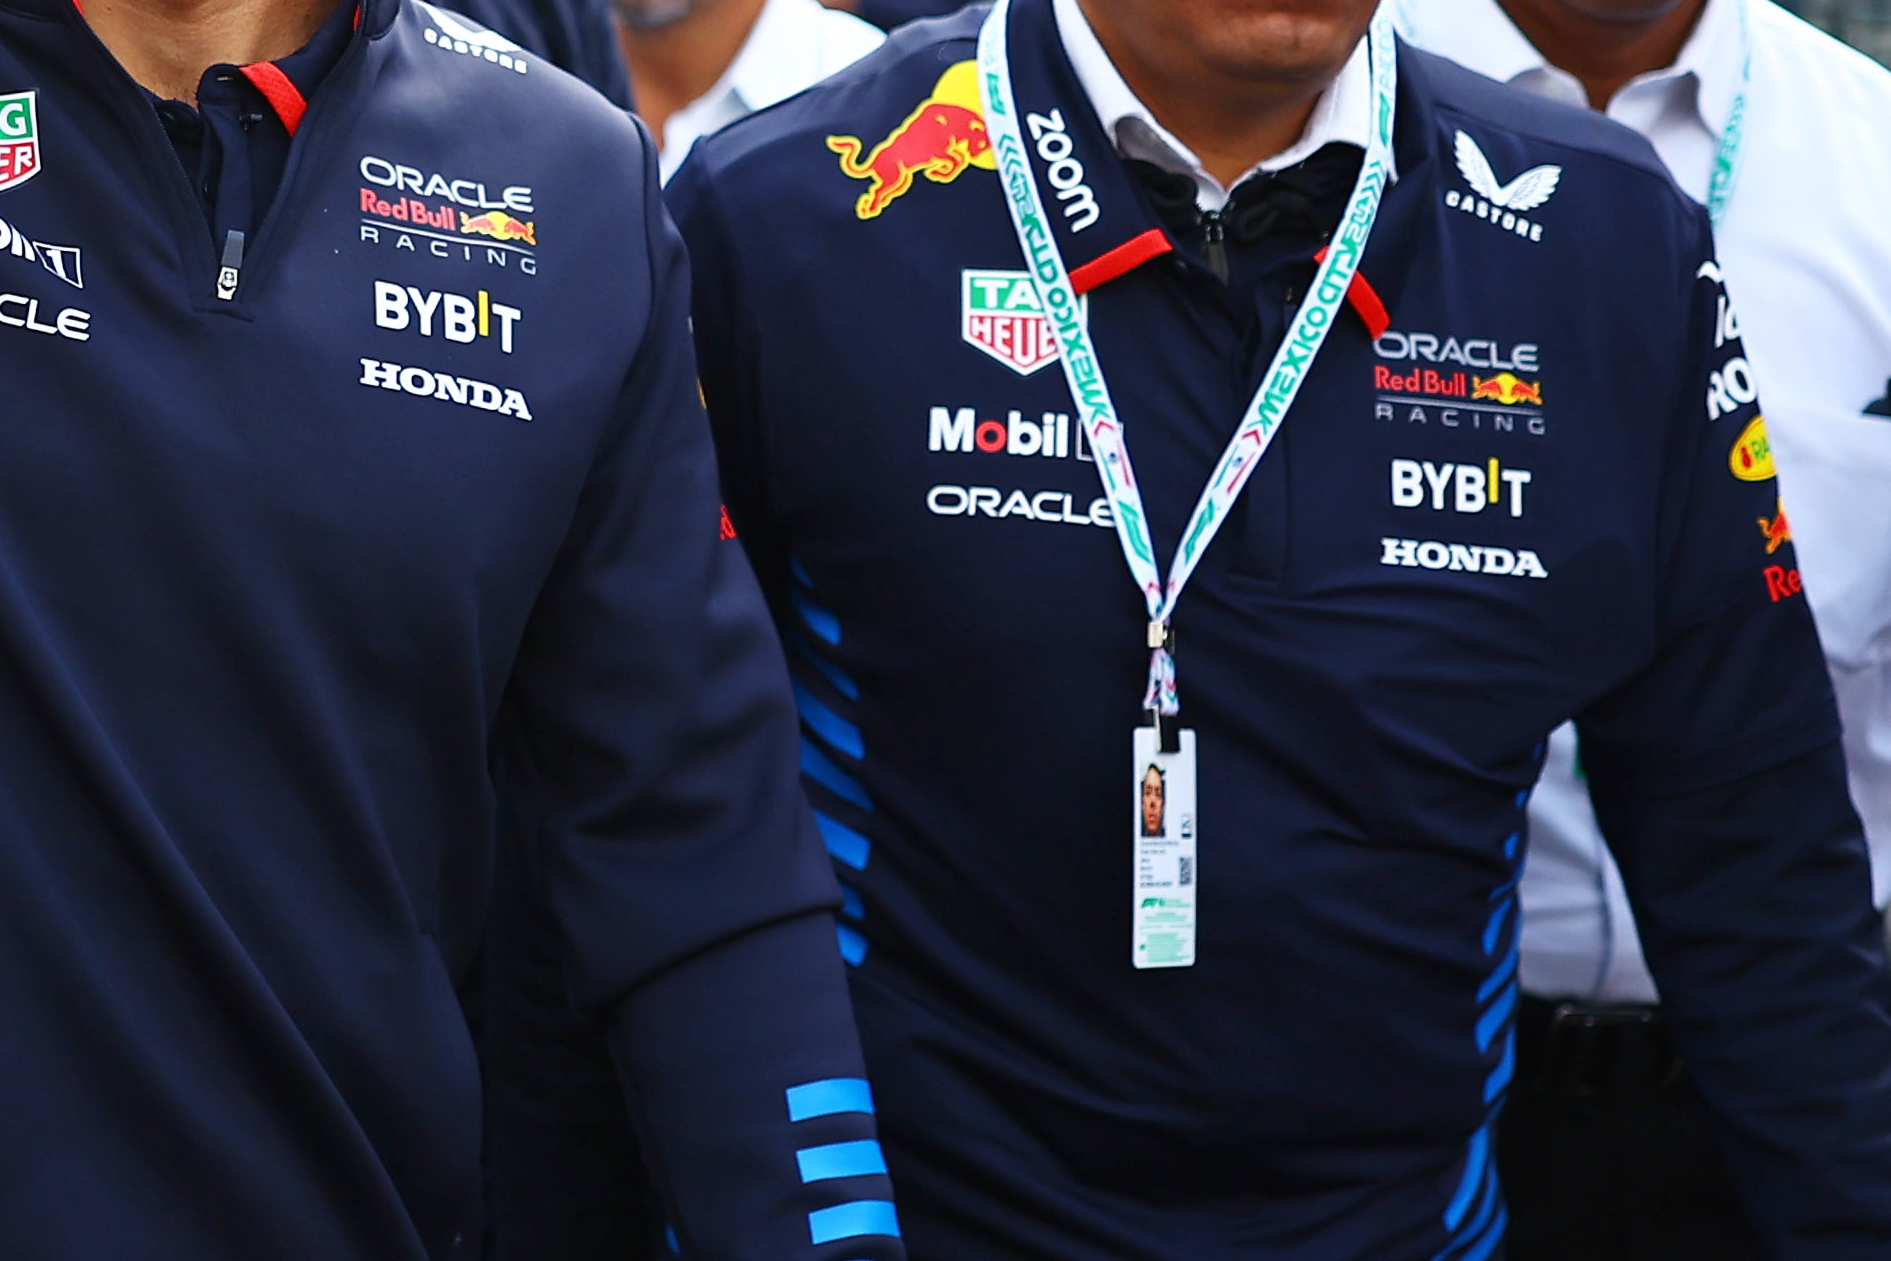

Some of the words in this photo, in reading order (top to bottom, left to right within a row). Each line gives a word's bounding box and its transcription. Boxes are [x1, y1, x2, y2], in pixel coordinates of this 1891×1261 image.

[359, 155, 535, 214] ORACLE
[1026, 107, 1101, 234] zoom
[359, 188, 410, 222] Red
[410, 196, 457, 233] Bull
[1444, 189, 1544, 243] CASTORE
[360, 225, 537, 276] RACING
[373, 280, 522, 355] BYBIT
[969, 277, 1043, 311] TA
[969, 313, 1057, 368] HEUE
[1372, 329, 1540, 372] ORACLE
[359, 357, 533, 422] HONDA
[1374, 364, 1421, 393] Red
[1423, 368, 1467, 397] Bull
[928, 406, 1069, 459] Mobil
[1375, 403, 1546, 436] RACING
[926, 484, 1116, 527] ORACLE
[1391, 457, 1532, 518] BYBIT
[1380, 537, 1549, 579] HONDA
[1763, 564, 1802, 602] Re
